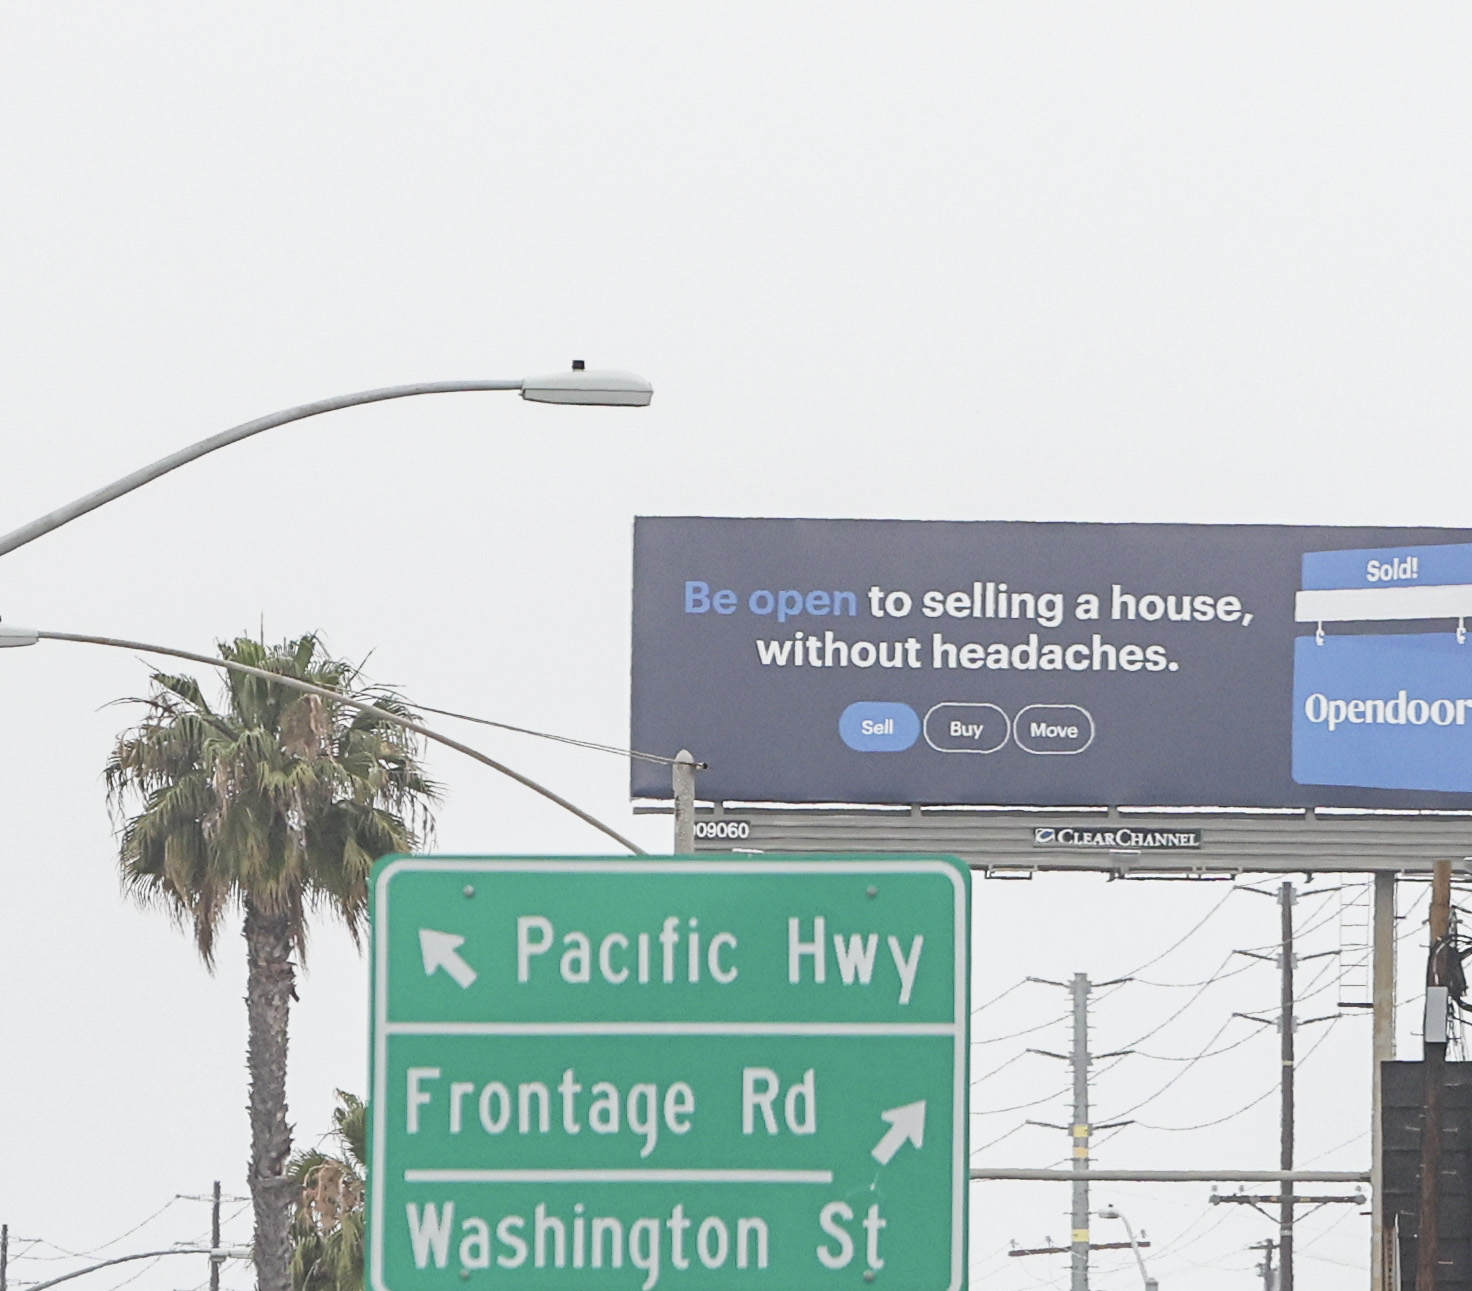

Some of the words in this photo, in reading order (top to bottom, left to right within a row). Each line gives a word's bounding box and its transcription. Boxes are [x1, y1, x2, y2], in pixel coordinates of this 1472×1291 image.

[1367, 557, 1417, 581] Sold!
[685, 581, 737, 614] Be
[749, 590, 856, 622] open
[869, 587, 912, 617] to
[922, 582, 1063, 627] selling
[1076, 594, 1099, 619] a
[1112, 585, 1253, 626] house,
[757, 631, 921, 668] without
[933, 634, 1178, 671] headaches.
[862, 719, 893, 734] Sell
[951, 721, 983, 739] Buy
[1031, 723, 1078, 738] Move
[1305, 691, 1472, 729] Opendoor
[693, 822, 750, 839] 09060
[518, 916, 737, 983] Pacific
[789, 917, 923, 1004] Hwy
[407, 1068, 694, 1157] Frontage
[743, 1068, 816, 1134] Rd
[406, 1202, 768, 1291] Washington
[817, 1202, 886, 1270] St
